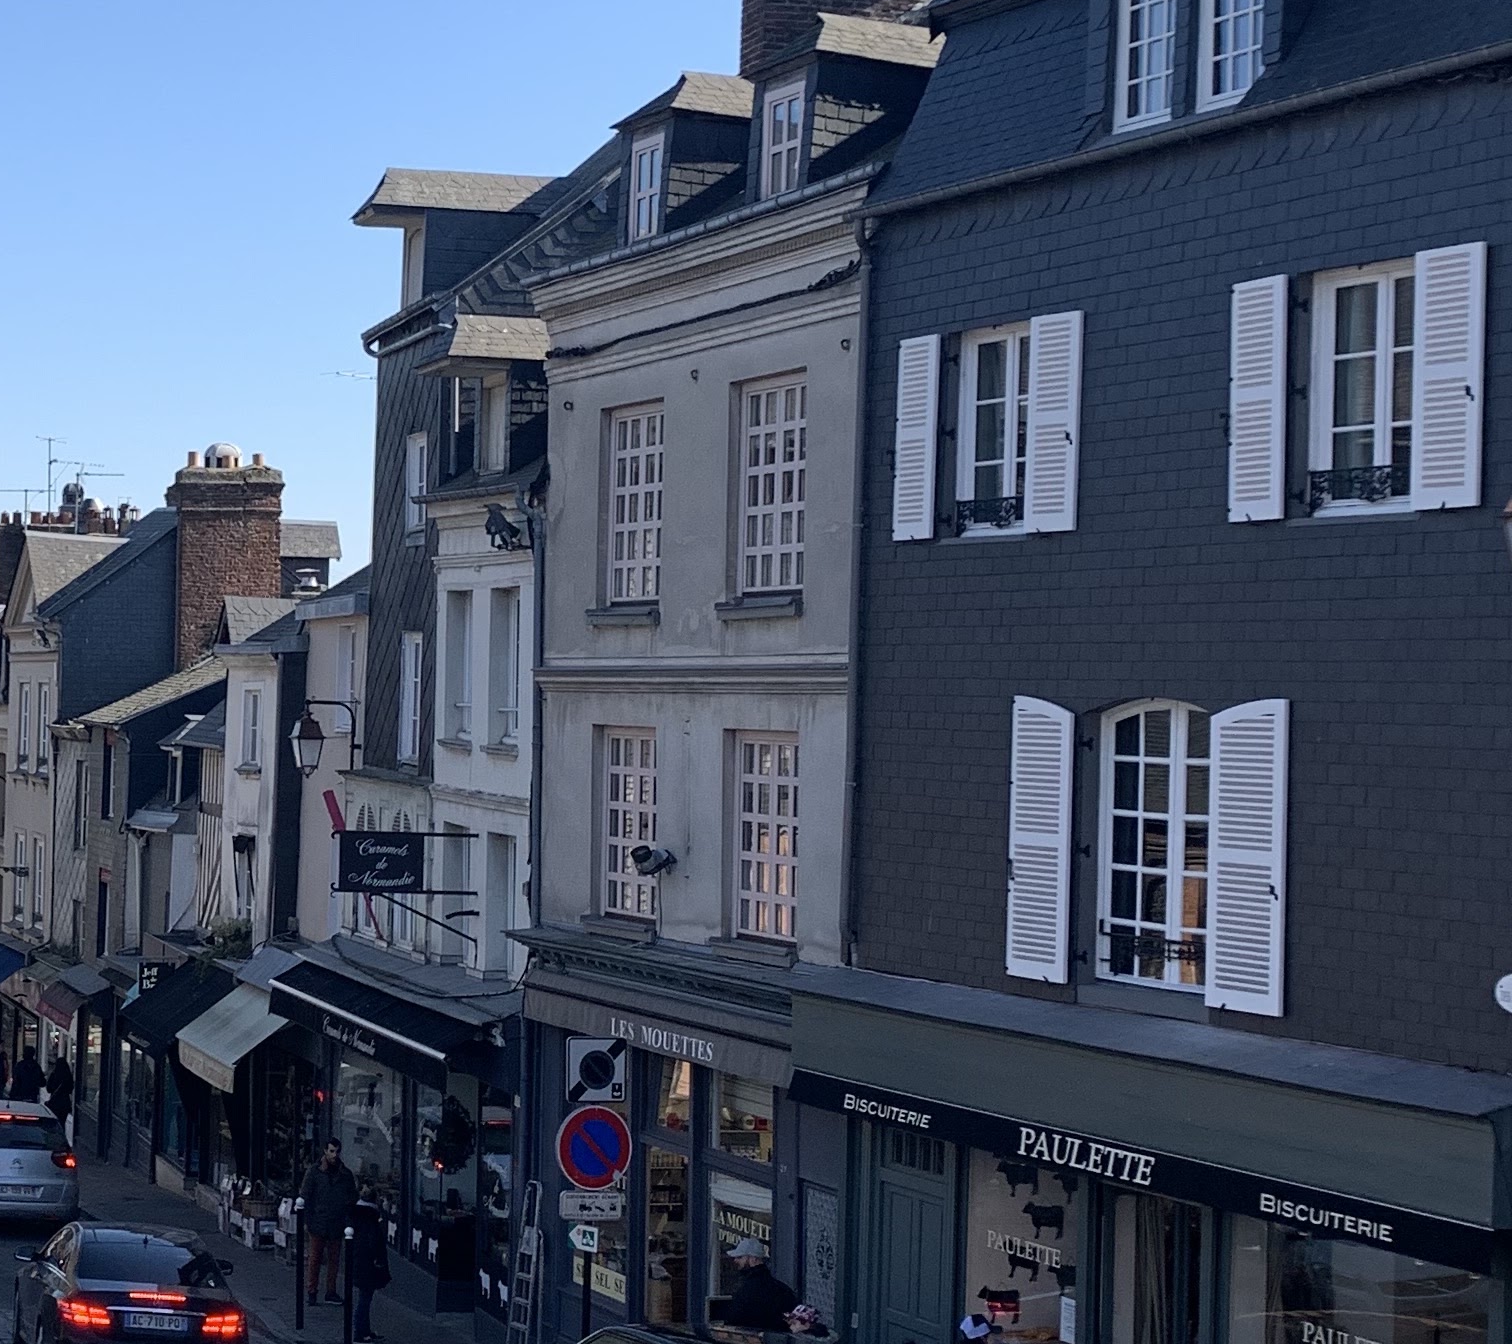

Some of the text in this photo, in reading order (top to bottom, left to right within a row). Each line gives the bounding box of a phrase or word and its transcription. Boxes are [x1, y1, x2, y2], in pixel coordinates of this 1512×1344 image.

[355, 838, 410, 857] Caramels
[375, 856, 388, 869] de
[348, 870, 416, 887] Normandie
[610, 1017, 714, 1062] LES MOUETTES
[843, 1093, 932, 1129] BISCUITERIE
[1017, 1126, 1156, 1186] PAULETTE
[1259, 1192, 1394, 1243] BISCUITERIE
[987, 1229, 1062, 1269] PAULETTE
[595, 1269, 610, 1290] SEL
